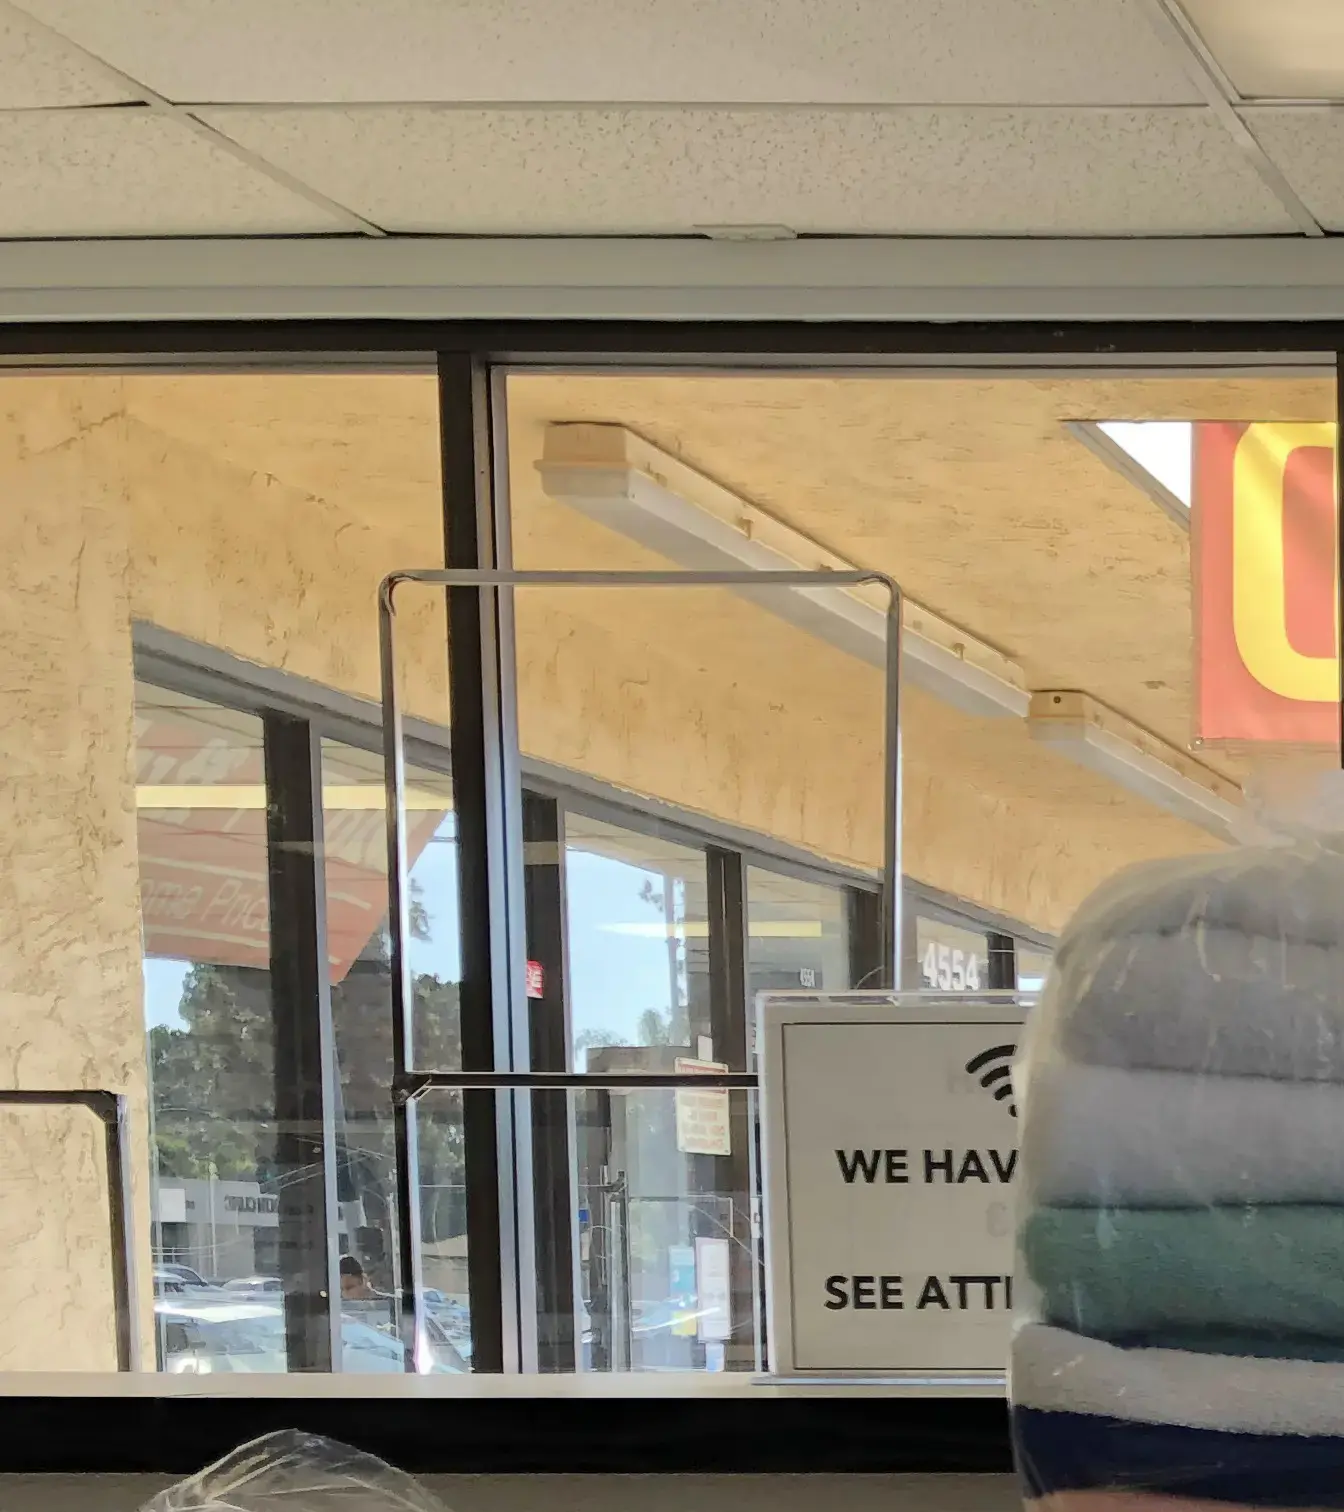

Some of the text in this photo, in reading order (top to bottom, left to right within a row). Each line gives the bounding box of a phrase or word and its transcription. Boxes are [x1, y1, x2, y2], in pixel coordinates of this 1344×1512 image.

[922, 941, 982, 991] 4554
[835, 1149, 1020, 1184] WE HAV
[824, 1275, 904, 1310] SEE
